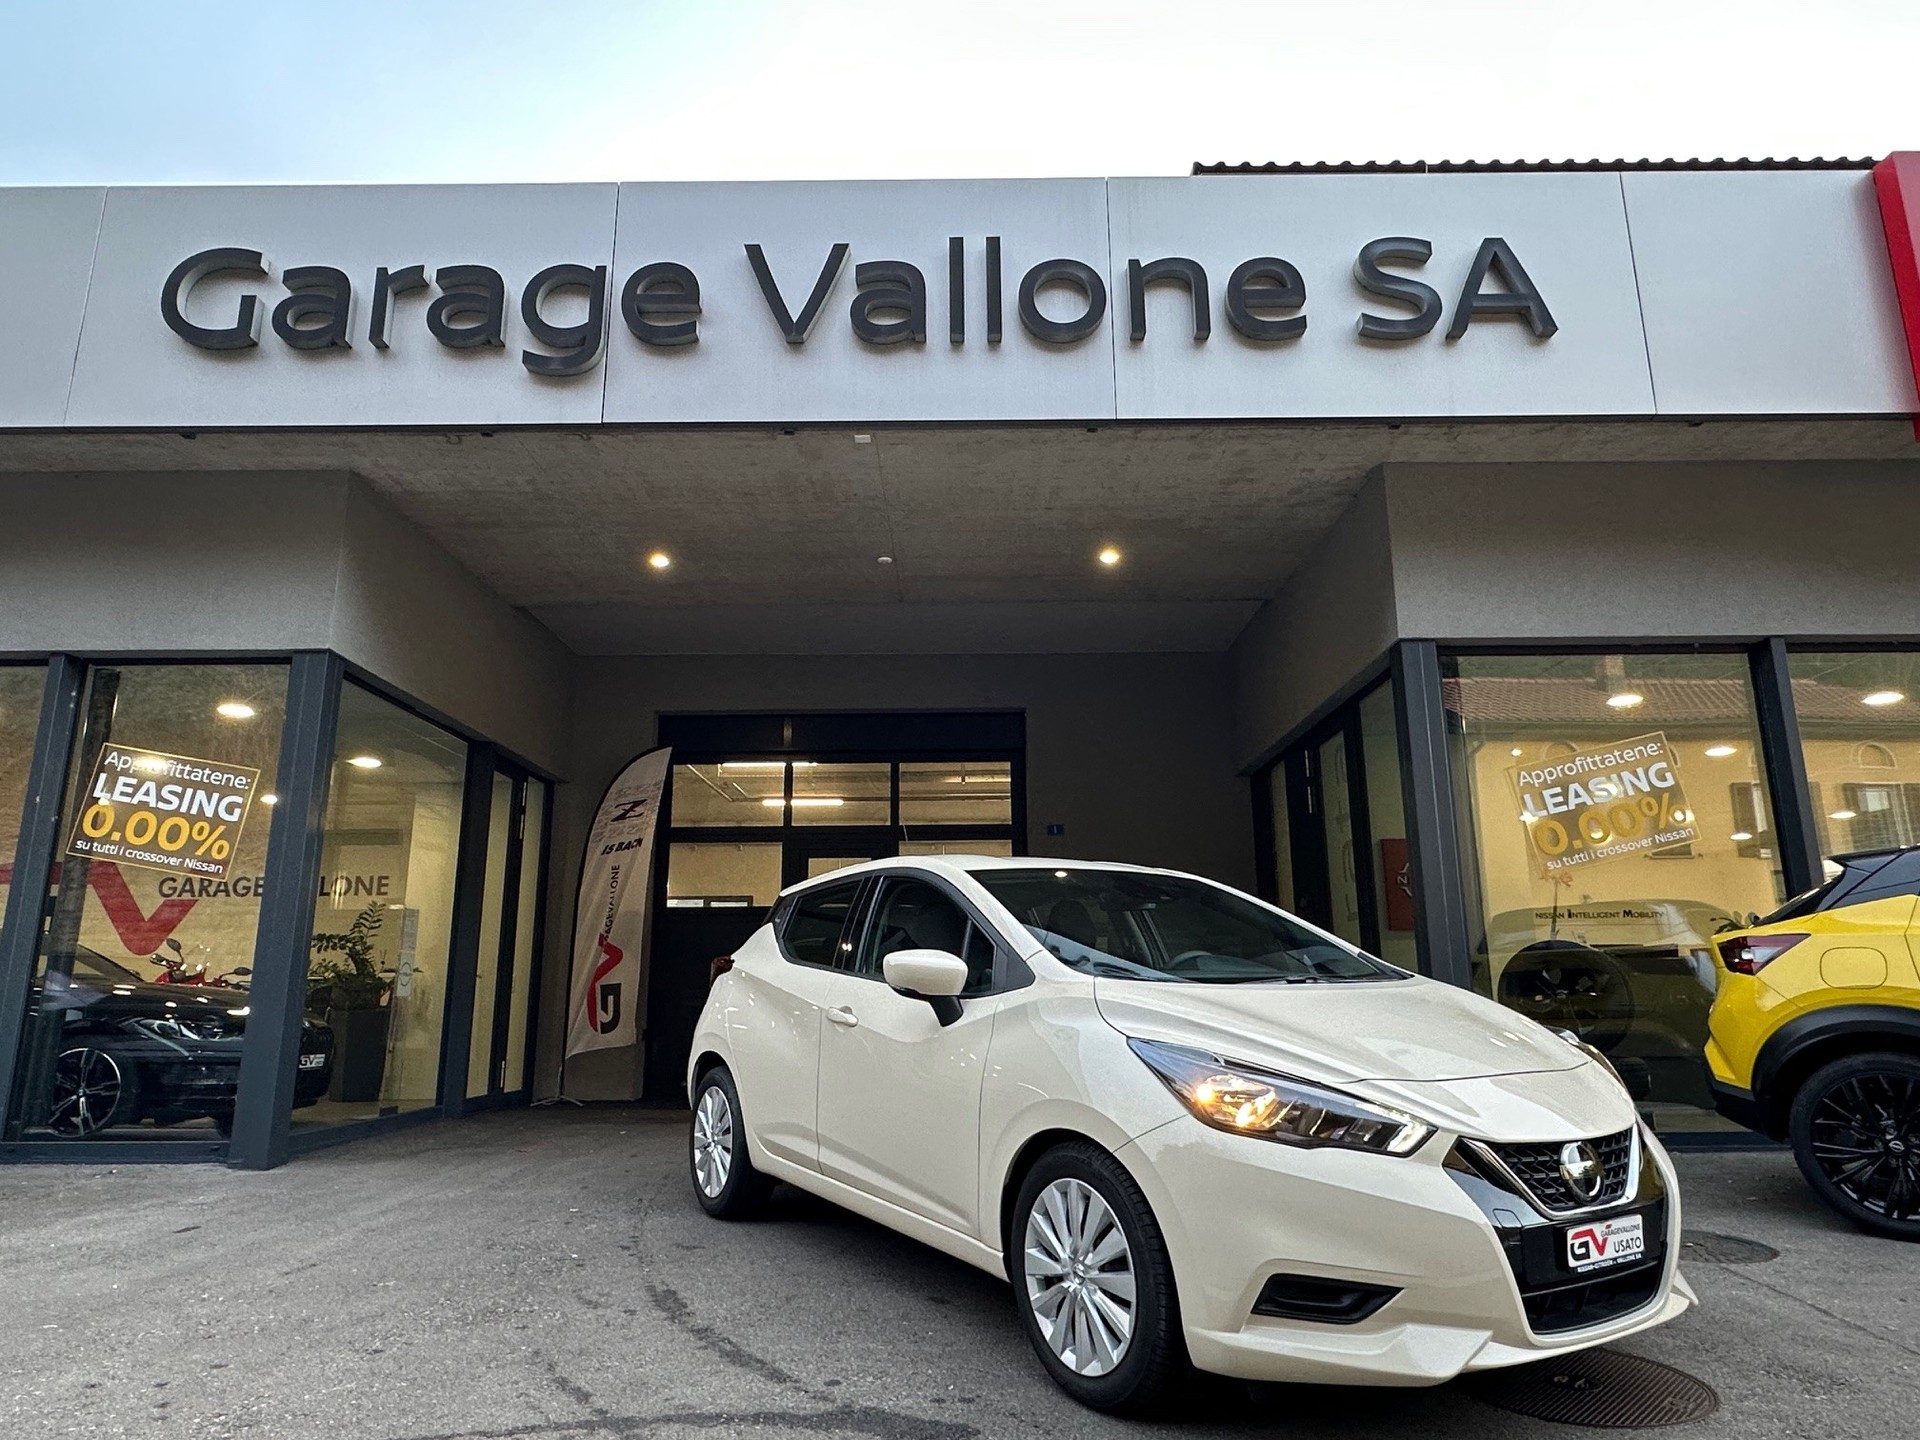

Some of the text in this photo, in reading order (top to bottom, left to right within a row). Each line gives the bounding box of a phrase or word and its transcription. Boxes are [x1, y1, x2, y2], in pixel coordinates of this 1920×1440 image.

[161, 236, 1559, 376] Garage Vallone SA
[104, 751, 251, 790] Apfittatene:
[1518, 741, 1664, 787] Approfittatene:
[93, 772, 244, 822] LEASING
[1523, 761, 1676, 818] LEASING
[82, 802, 230, 860] 0.00%
[1534, 792, 1689, 855] 0.00%
[75, 839, 223, 874] su tutti i crossover Nissan
[1546, 860, 1561, 870] su
[1563, 852, 1589, 865] tutti
[1597, 837, 1653, 858] crossover
[1655, 827, 1695, 844] Nissan
[1613, 1236, 1642, 1253] USATO
